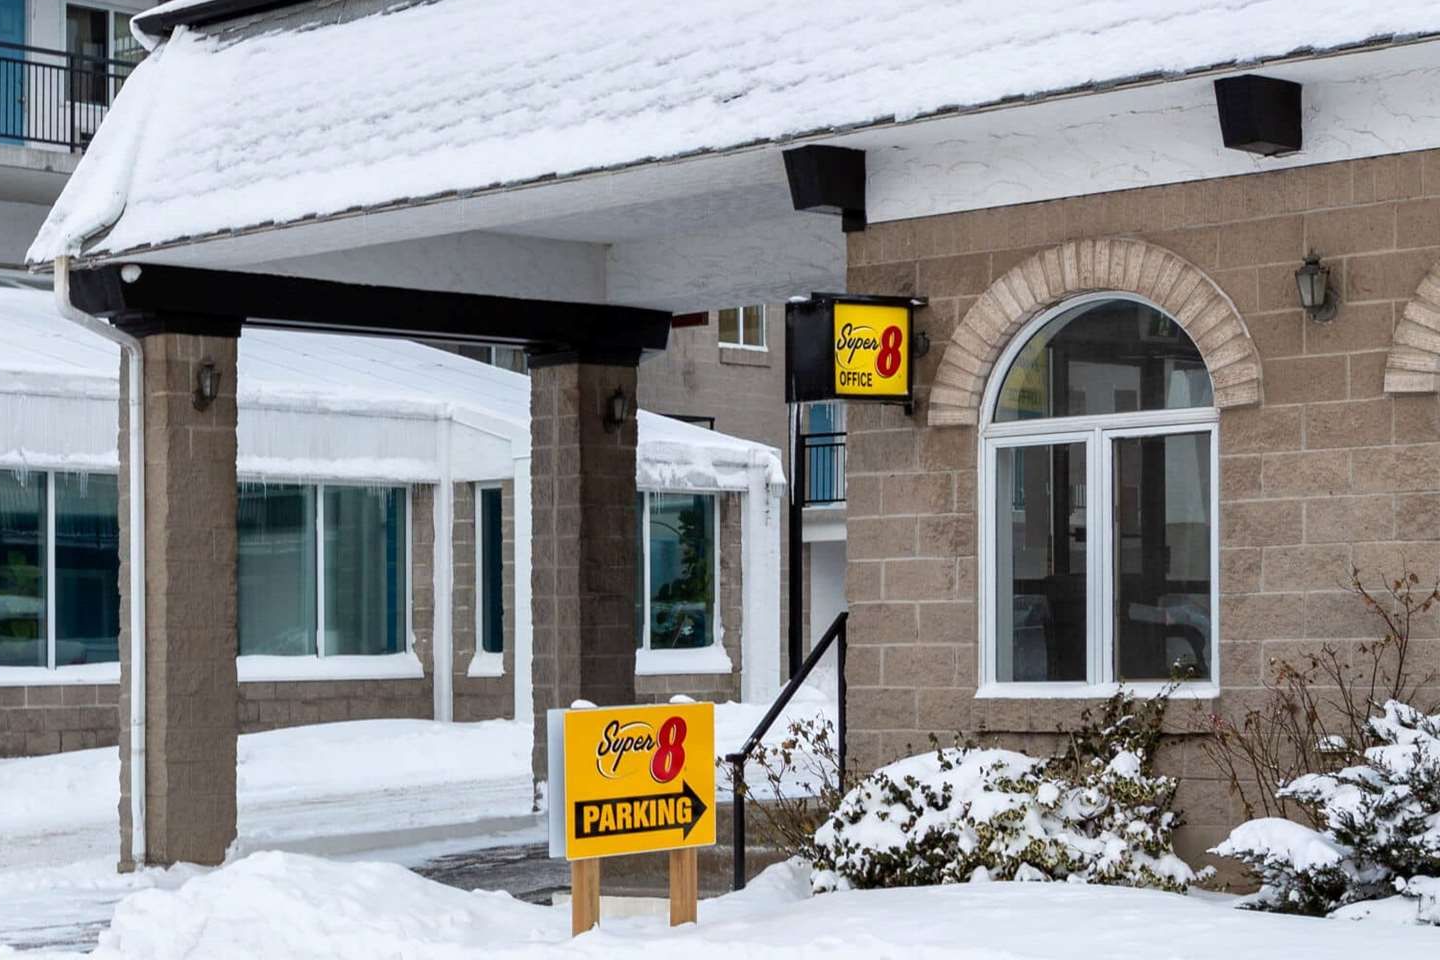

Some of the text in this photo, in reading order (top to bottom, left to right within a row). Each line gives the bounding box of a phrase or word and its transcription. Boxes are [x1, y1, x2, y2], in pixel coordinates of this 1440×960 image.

[837, 323, 903, 378] Super 8
[840, 371, 872, 387] OFFICE
[597, 716, 687, 783] Super 8
[583, 796, 692, 834] PARKING
